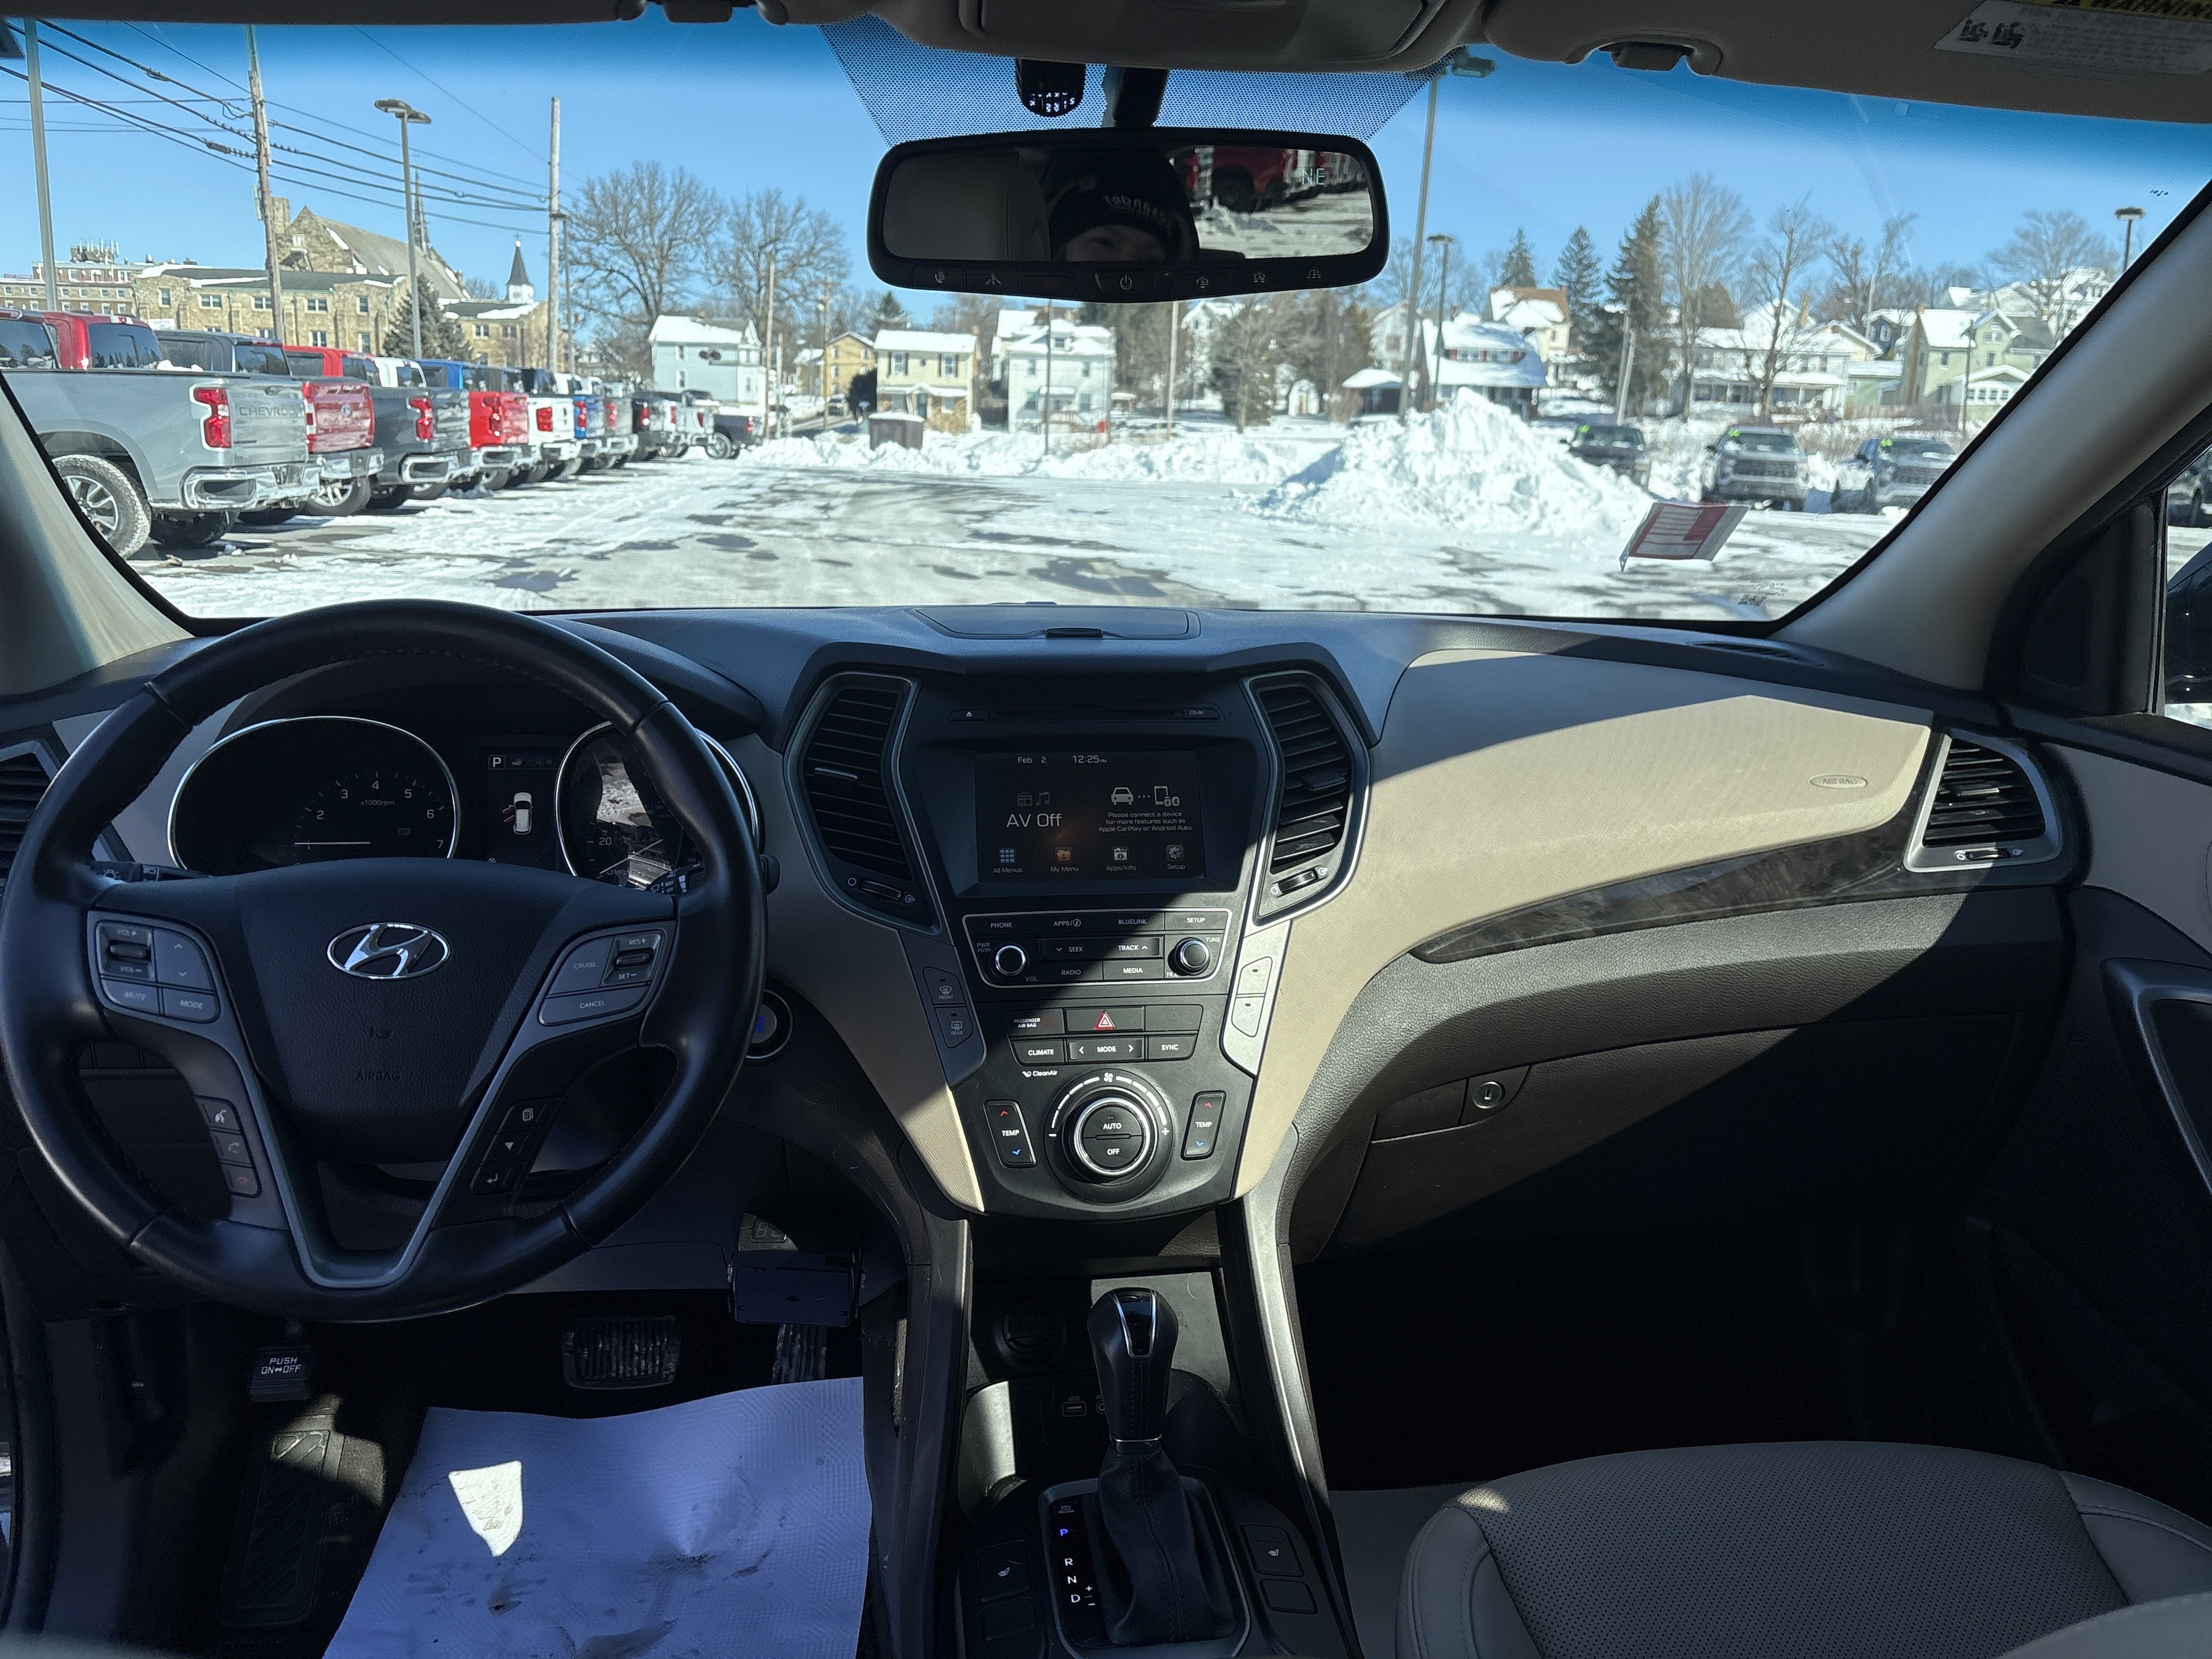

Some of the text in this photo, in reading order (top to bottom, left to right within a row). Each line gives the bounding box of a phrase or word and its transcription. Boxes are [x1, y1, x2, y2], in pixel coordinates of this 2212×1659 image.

[1302, 168, 1325, 186] NE
[493, 757, 501, 767] P
[371, 781, 380, 790] 4
[341, 789, 348, 799] 3
[404, 789, 412, 798] 5
[360, 799, 395, 808] x1000rpm
[317, 810, 324, 819] 2
[427, 809, 435, 819] 6
[1006, 813, 1062, 827] AV Off
[437, 839, 444, 849] 7
[599, 837, 612, 846] 20
[124, 991, 147, 1001] MUTE
[179, 1000, 205, 1009] MODE
[579, 1000, 606, 1009] CANCEL
[356, 1071, 400, 1081] AIRBAG
[269, 1357, 298, 1365] PUSH
[261, 1364, 302, 1375] ON OFF
[1060, 1528, 1069, 1537] P
[1064, 1558, 1074, 1566] R
[1067, 1576, 1077, 1584] N
[1070, 1594, 1081, 1603] D
